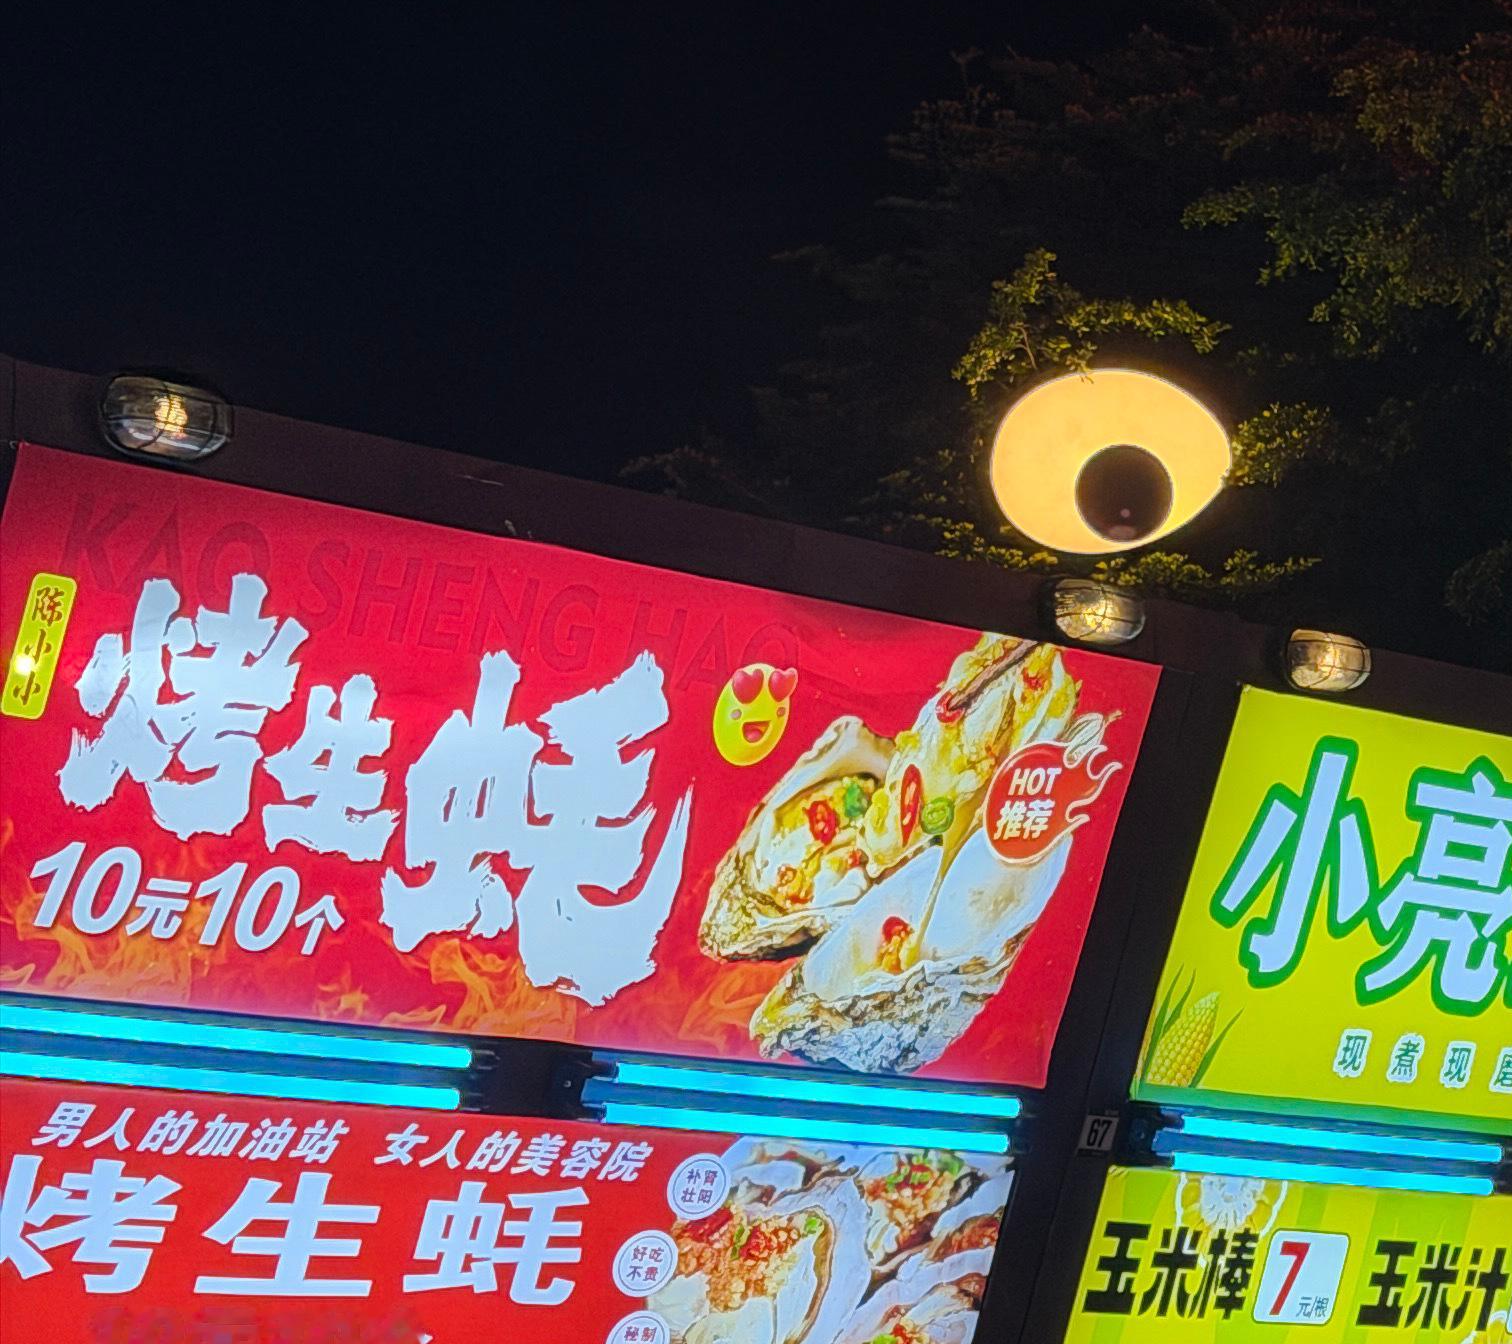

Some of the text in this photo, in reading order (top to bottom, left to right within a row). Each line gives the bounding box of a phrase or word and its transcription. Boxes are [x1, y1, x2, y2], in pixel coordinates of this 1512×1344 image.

[55, 572, 695, 1008] 烤生蚝
[994, 800, 1056, 841] 推荐
[1008, 766, 1061, 794] HOT
[29, 841, 345, 956] 10元10个
[32, 1101, 654, 1183] 男人的加油站 女人的美容院
[1084, 1117, 1112, 1147] 67
[1082, 1221, 1260, 1320] 玉米棒
[1356, 1239, 1510, 1331] 玉米汁
